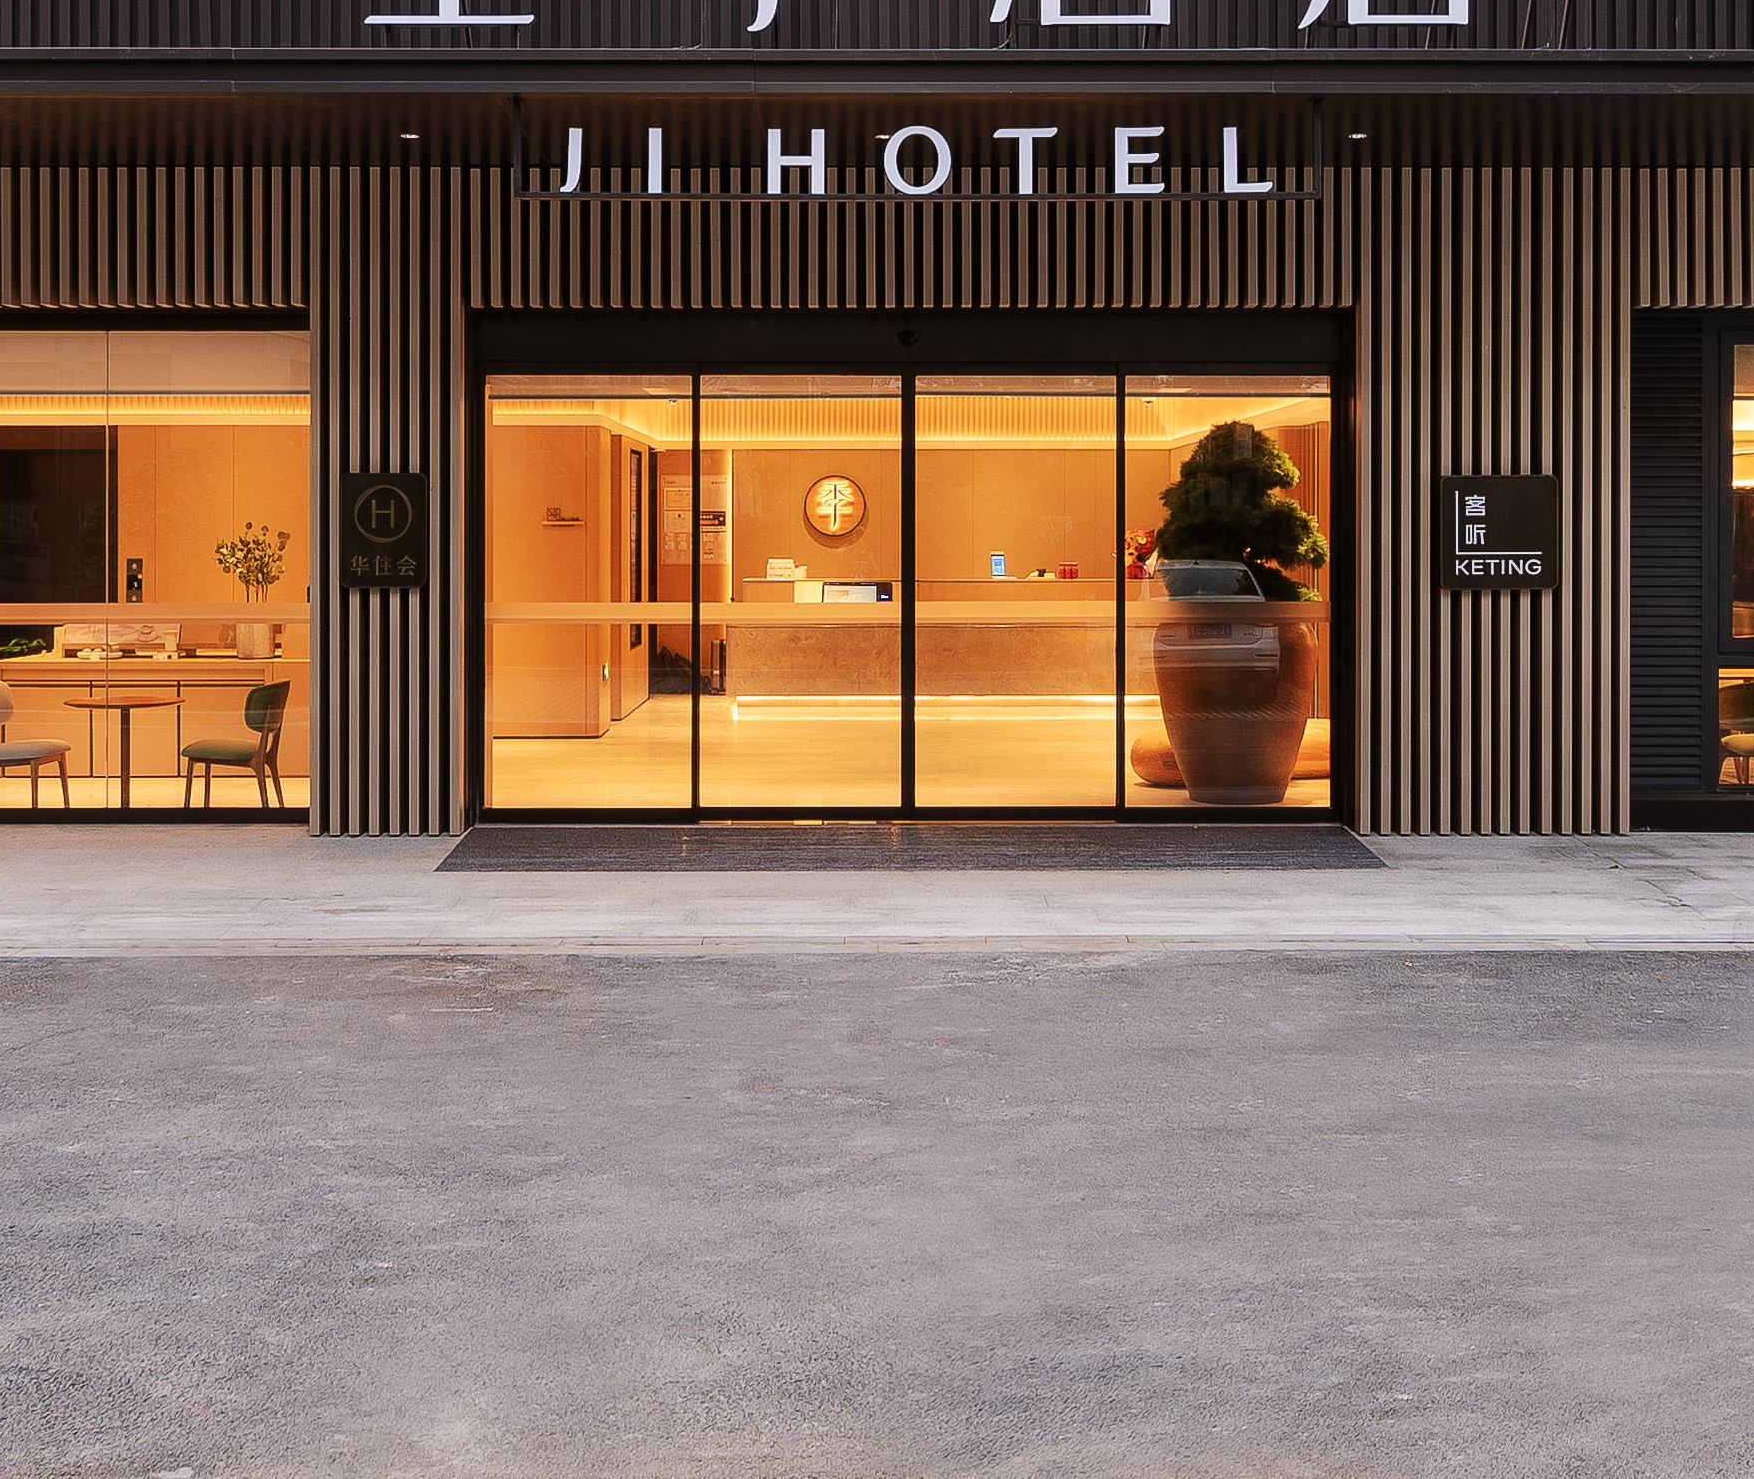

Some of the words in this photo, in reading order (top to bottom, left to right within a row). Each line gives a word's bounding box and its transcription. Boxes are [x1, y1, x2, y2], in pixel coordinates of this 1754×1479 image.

[559, 126, 663, 194] JI
[767, 125, 1274, 195] HOTEL
[371, 499, 395, 529] H
[816, 481, 853, 531] 季
[350, 554, 417, 576] 华住会
[1455, 558, 1543, 575] KETING
